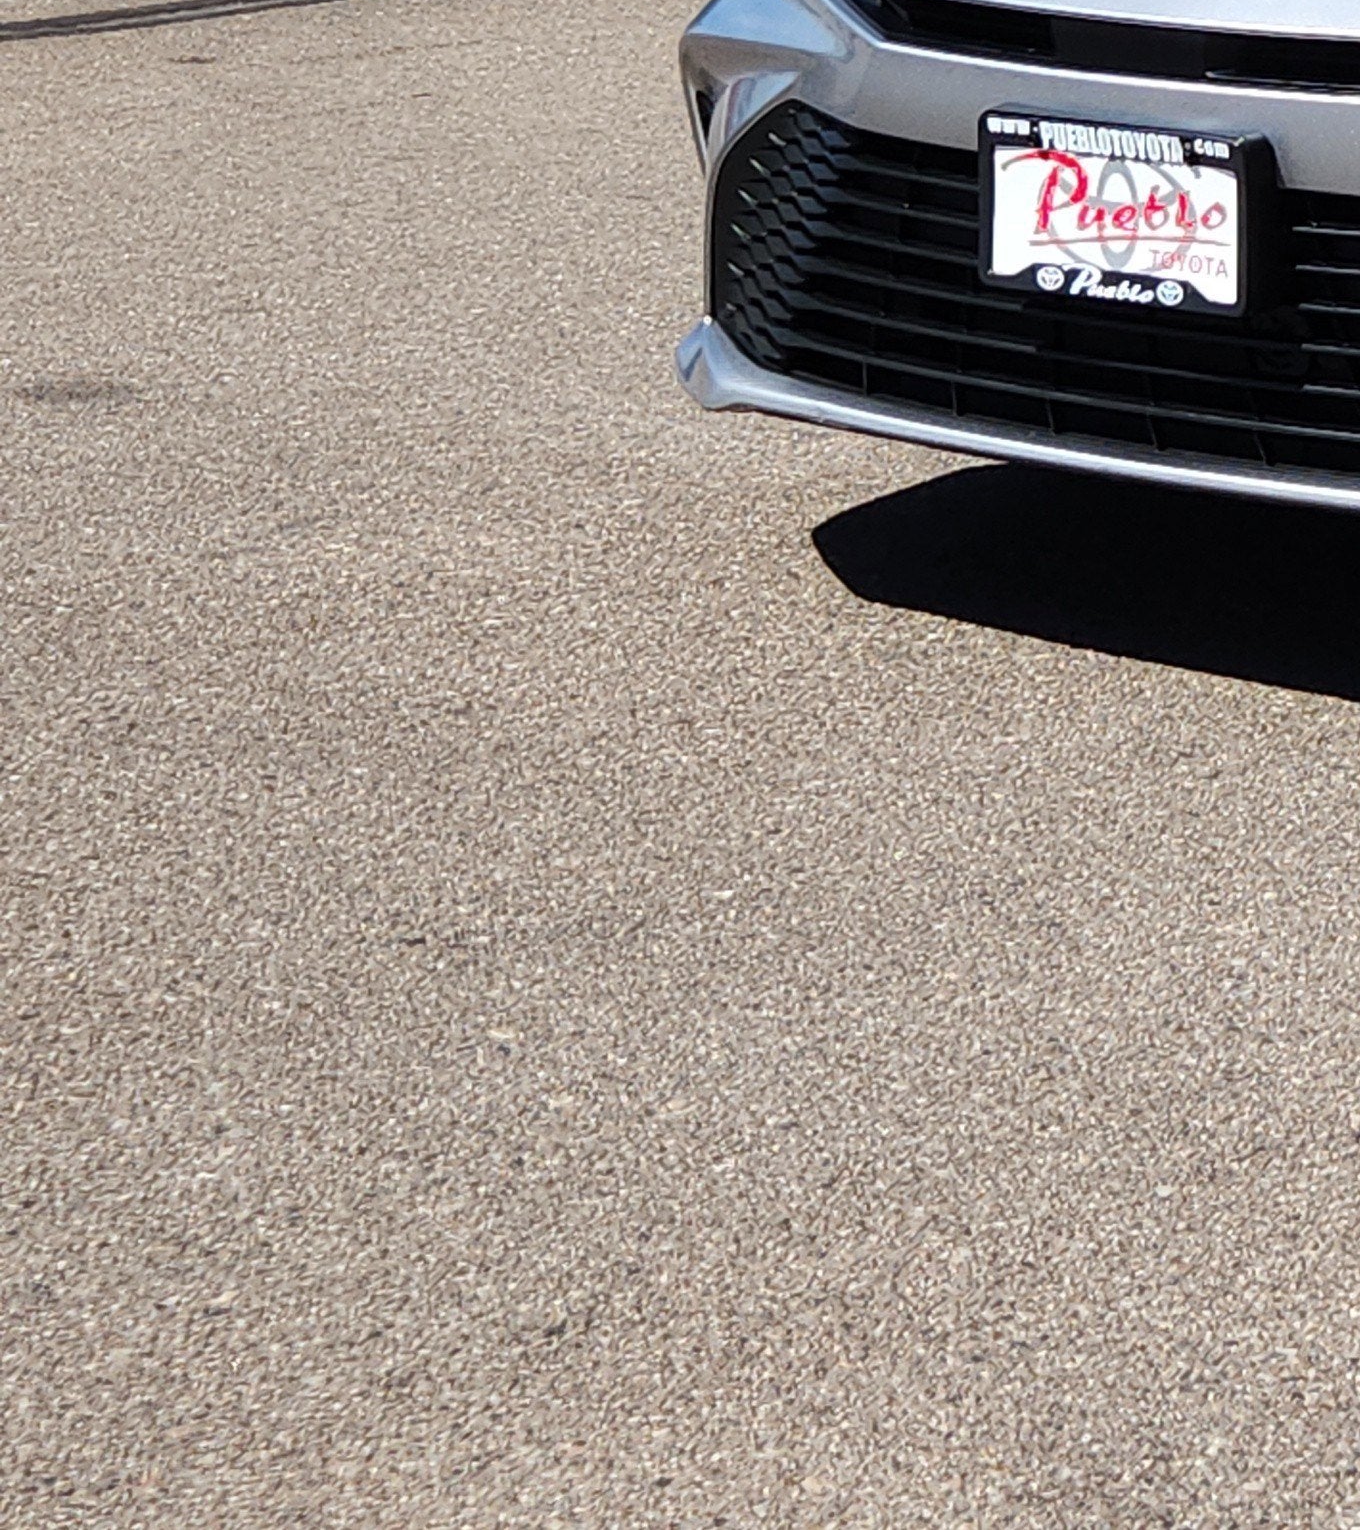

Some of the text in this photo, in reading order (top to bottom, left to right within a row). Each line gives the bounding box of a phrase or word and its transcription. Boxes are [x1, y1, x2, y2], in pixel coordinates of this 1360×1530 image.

[1001, 149, 1228, 235] Pueblo
[1061, 262, 1155, 304] Pueblo
[1149, 248, 1228, 278] TOYOTA
